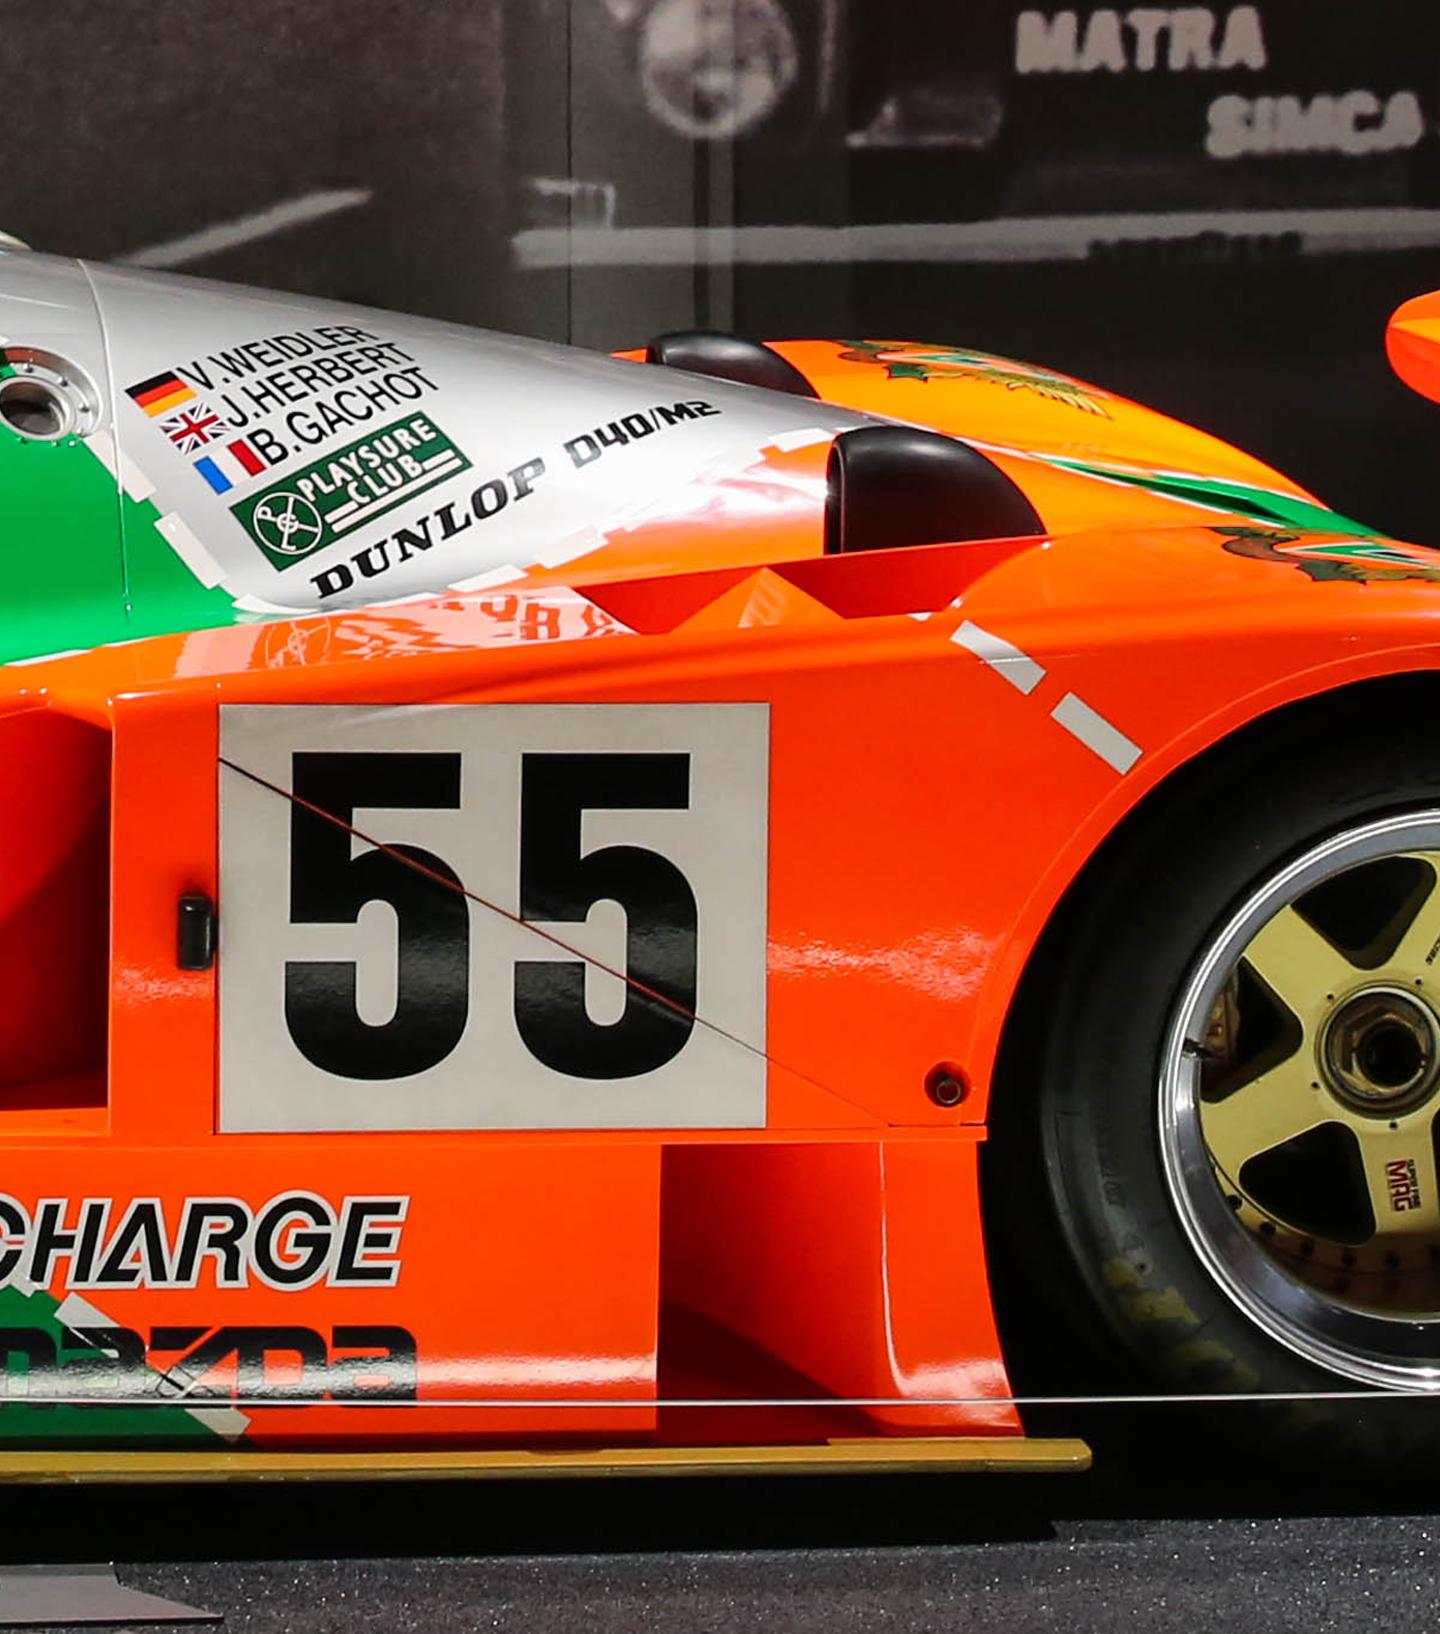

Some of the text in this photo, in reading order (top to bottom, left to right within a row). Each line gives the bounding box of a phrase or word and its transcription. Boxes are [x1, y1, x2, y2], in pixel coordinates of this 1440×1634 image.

[1015, 8, 1269, 75] MATRA
[1206, 92, 1425, 157] SIMCA
[174, 325, 385, 391] V.WEIDLER
[218, 342, 417, 428] J.HERBERT
[296, 419, 437, 502] PLAYSURE
[347, 454, 425, 505] CLUB
[310, 457, 548, 599] DUNLOP
[284, 752, 698, 1081] 55
